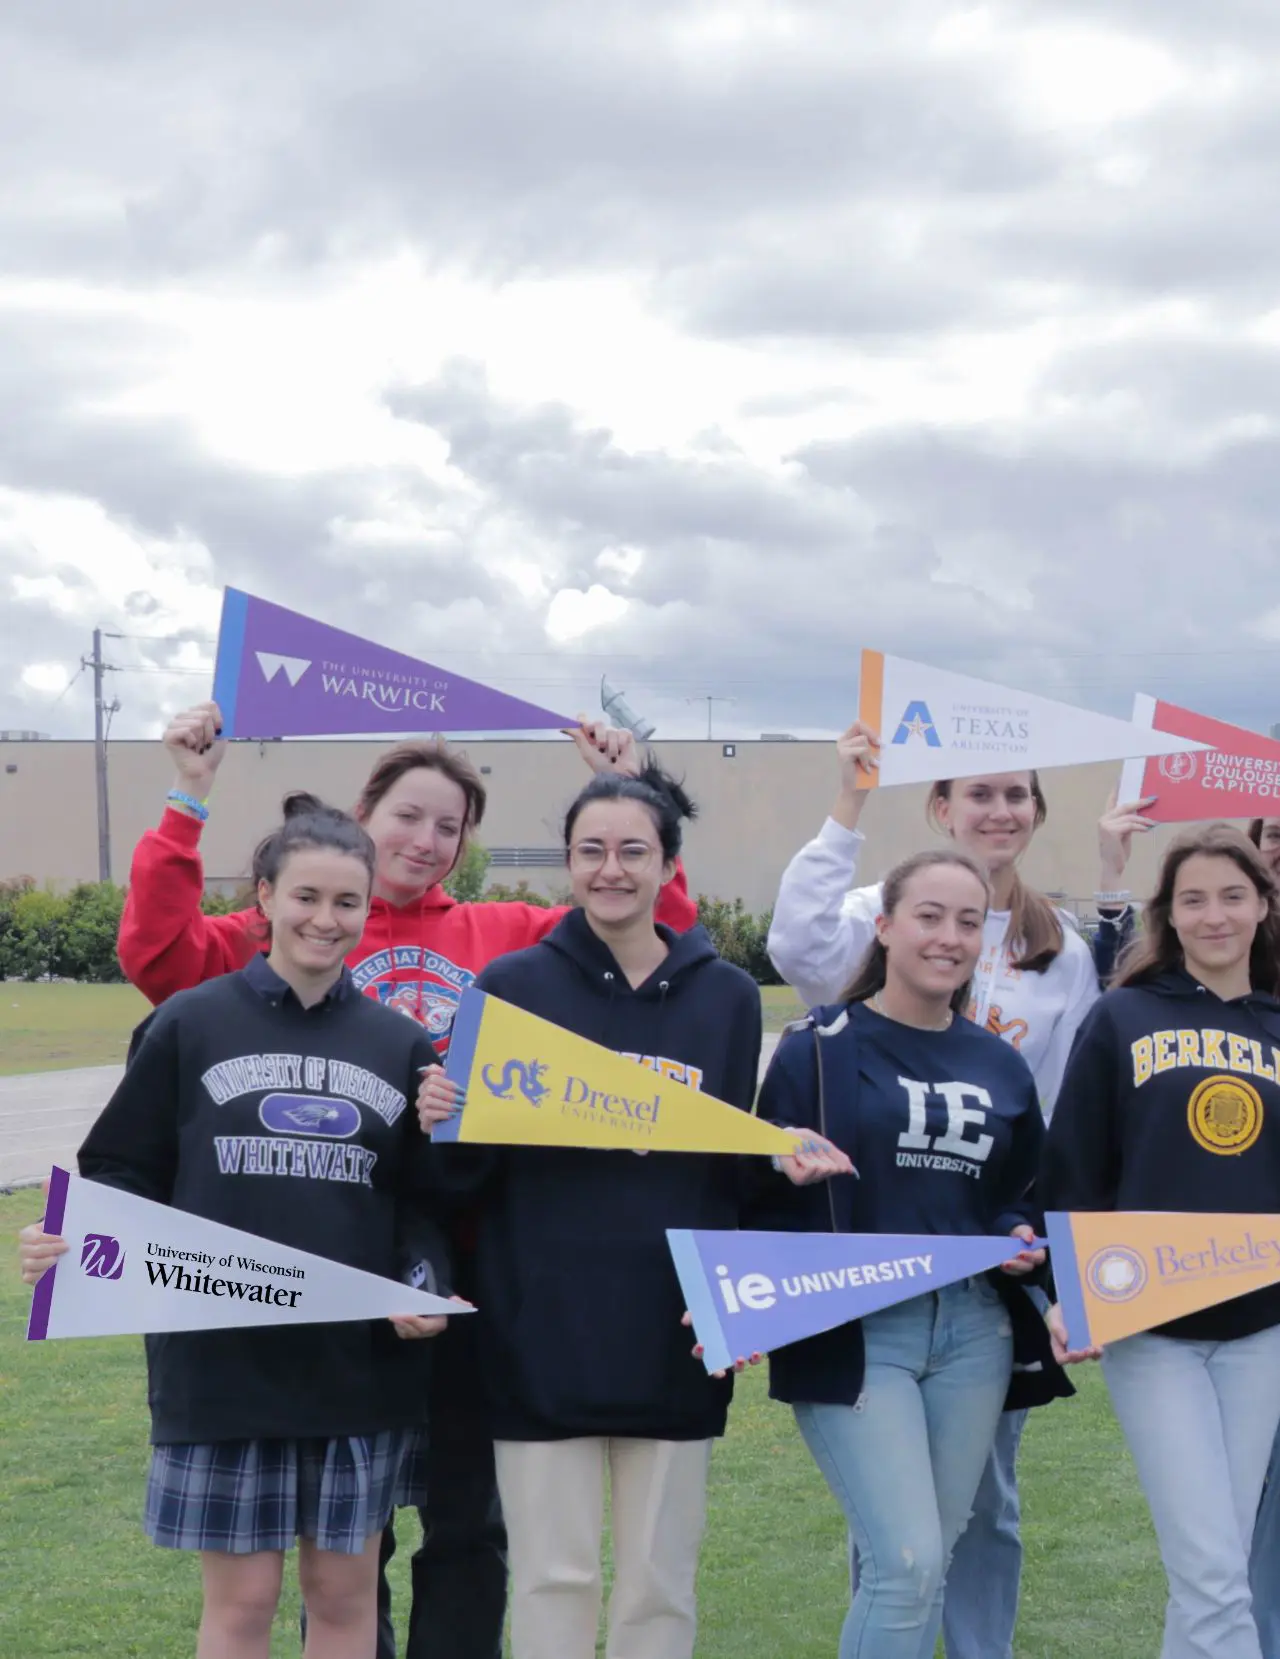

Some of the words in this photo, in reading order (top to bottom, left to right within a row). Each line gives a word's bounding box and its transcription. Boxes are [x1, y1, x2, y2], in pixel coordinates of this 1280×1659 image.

[322, 661, 345, 673] THE
[352, 662, 428, 688] UNIVERSITY
[434, 680, 449, 691] OF
[322, 674, 446, 712] WARWICK
[951, 716, 1029, 739] TEXAS
[952, 703, 1012, 715] UNIVERSITY
[951, 739, 1028, 753] ARLINGTON
[201, 1053, 302, 1106] UNIVERSITY
[305, 1056, 326, 1091] OF
[328, 1059, 408, 1127] WISCONSIN
[564, 1075, 660, 1123] Drexel
[561, 1105, 654, 1136] UNIVERSITY
[897, 1075, 995, 1161] IE
[147, 1242, 216, 1268] University
[219, 1254, 234, 1268] of
[237, 1257, 306, 1279] Wisconsin
[145, 1260, 303, 1308] Whitewater
[715, 1264, 777, 1314] ie
[781, 1254, 933, 1298] UNIVERSITY
